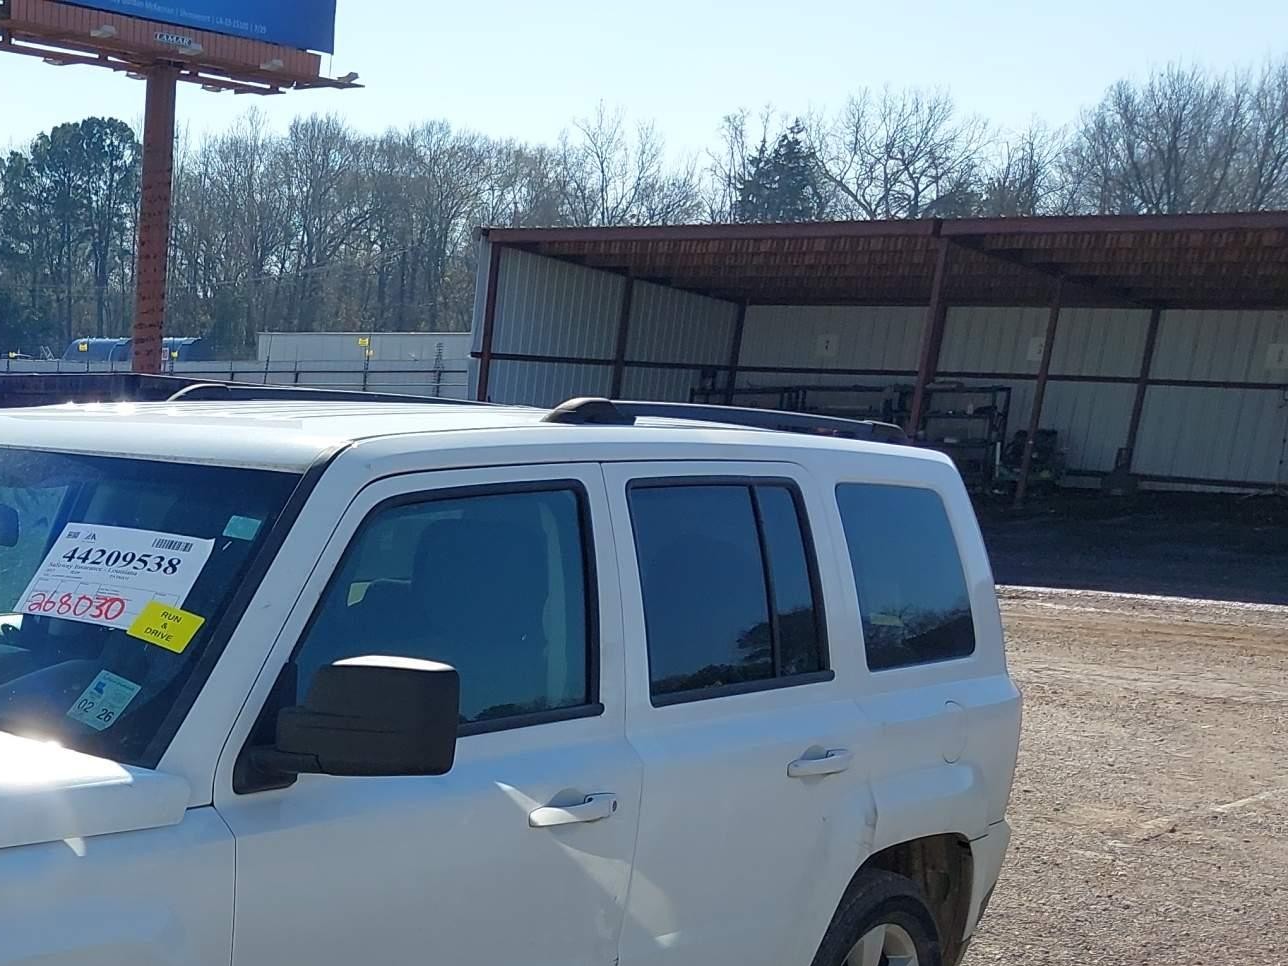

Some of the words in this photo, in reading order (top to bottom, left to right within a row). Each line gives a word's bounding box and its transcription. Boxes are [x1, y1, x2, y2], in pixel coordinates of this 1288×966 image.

[156, 33, 191, 46] LAMAR
[62, 546, 182, 576] 44209538
[27, 592, 126, 621] 268030
[160, 611, 182, 624] RUN
[160, 622, 168, 630] &
[144, 627, 174, 642] DRIVE
[77, 698, 95, 713] 02
[96, 707, 115, 723] 26
